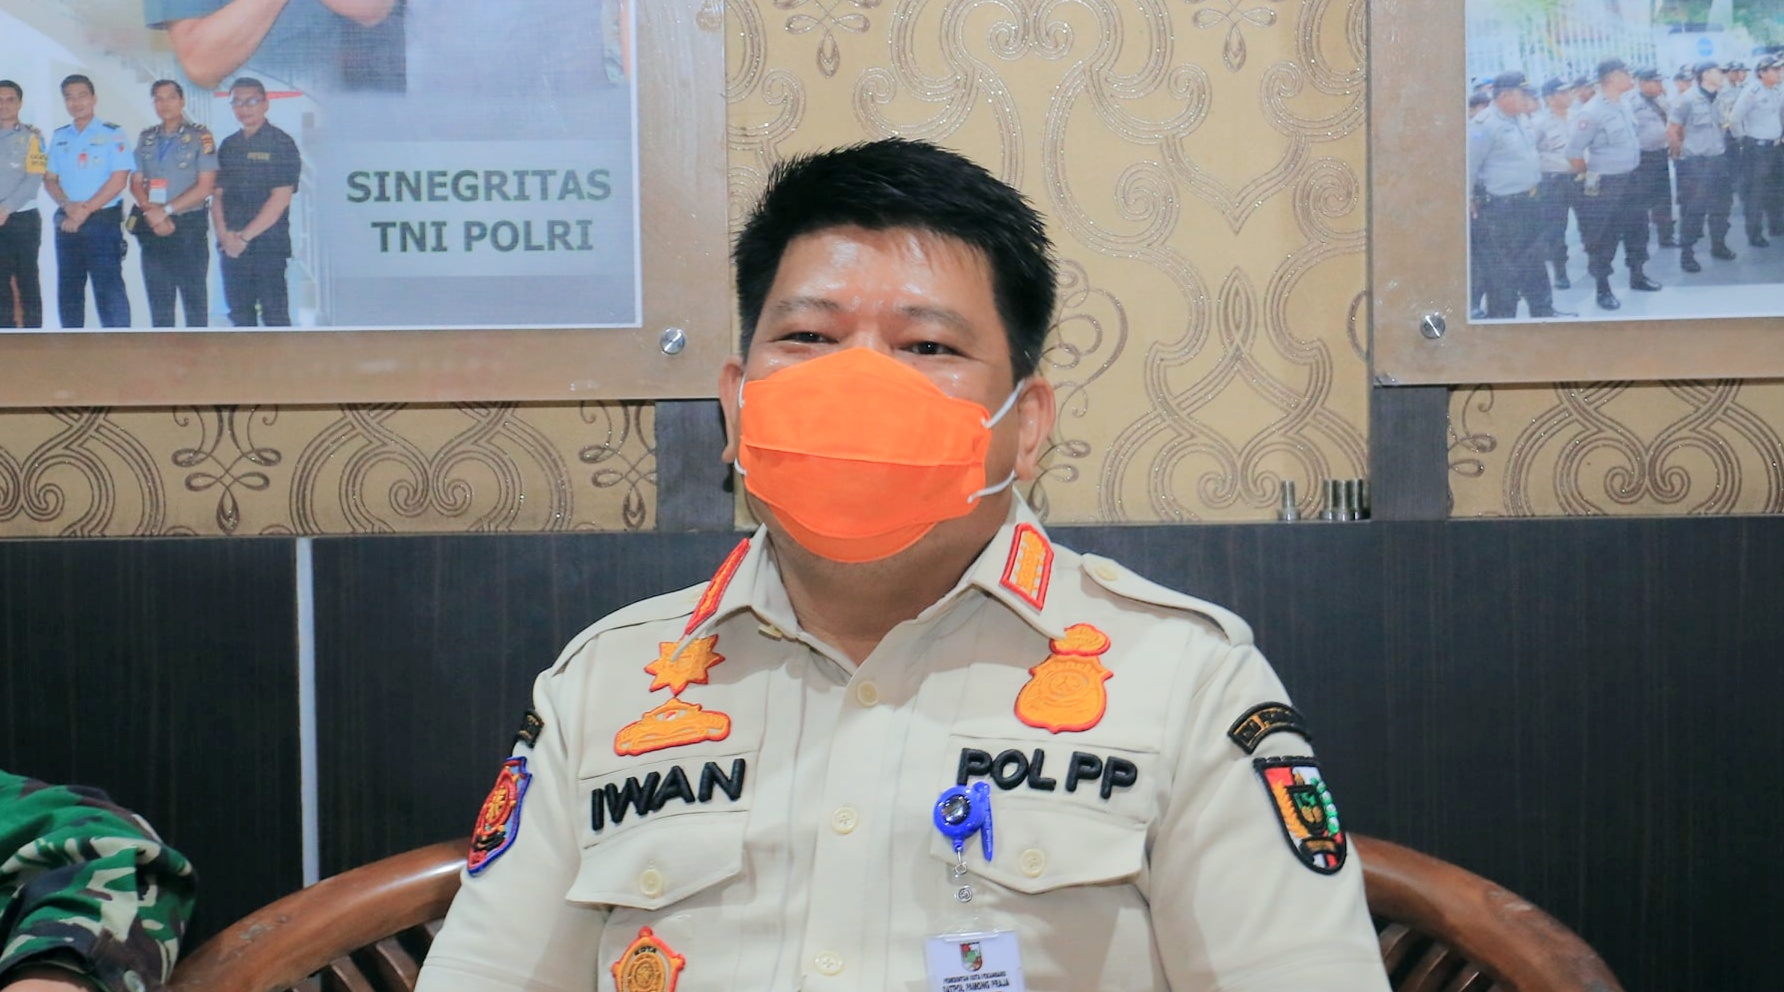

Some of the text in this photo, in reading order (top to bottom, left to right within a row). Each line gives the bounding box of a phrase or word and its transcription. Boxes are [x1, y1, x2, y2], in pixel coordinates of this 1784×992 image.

[346, 169, 611, 203] SINEGRITAS
[370, 219, 593, 252] TNI POLRI
[591, 758, 745, 831] IWAN
[957, 747, 1138, 800] POL PP
